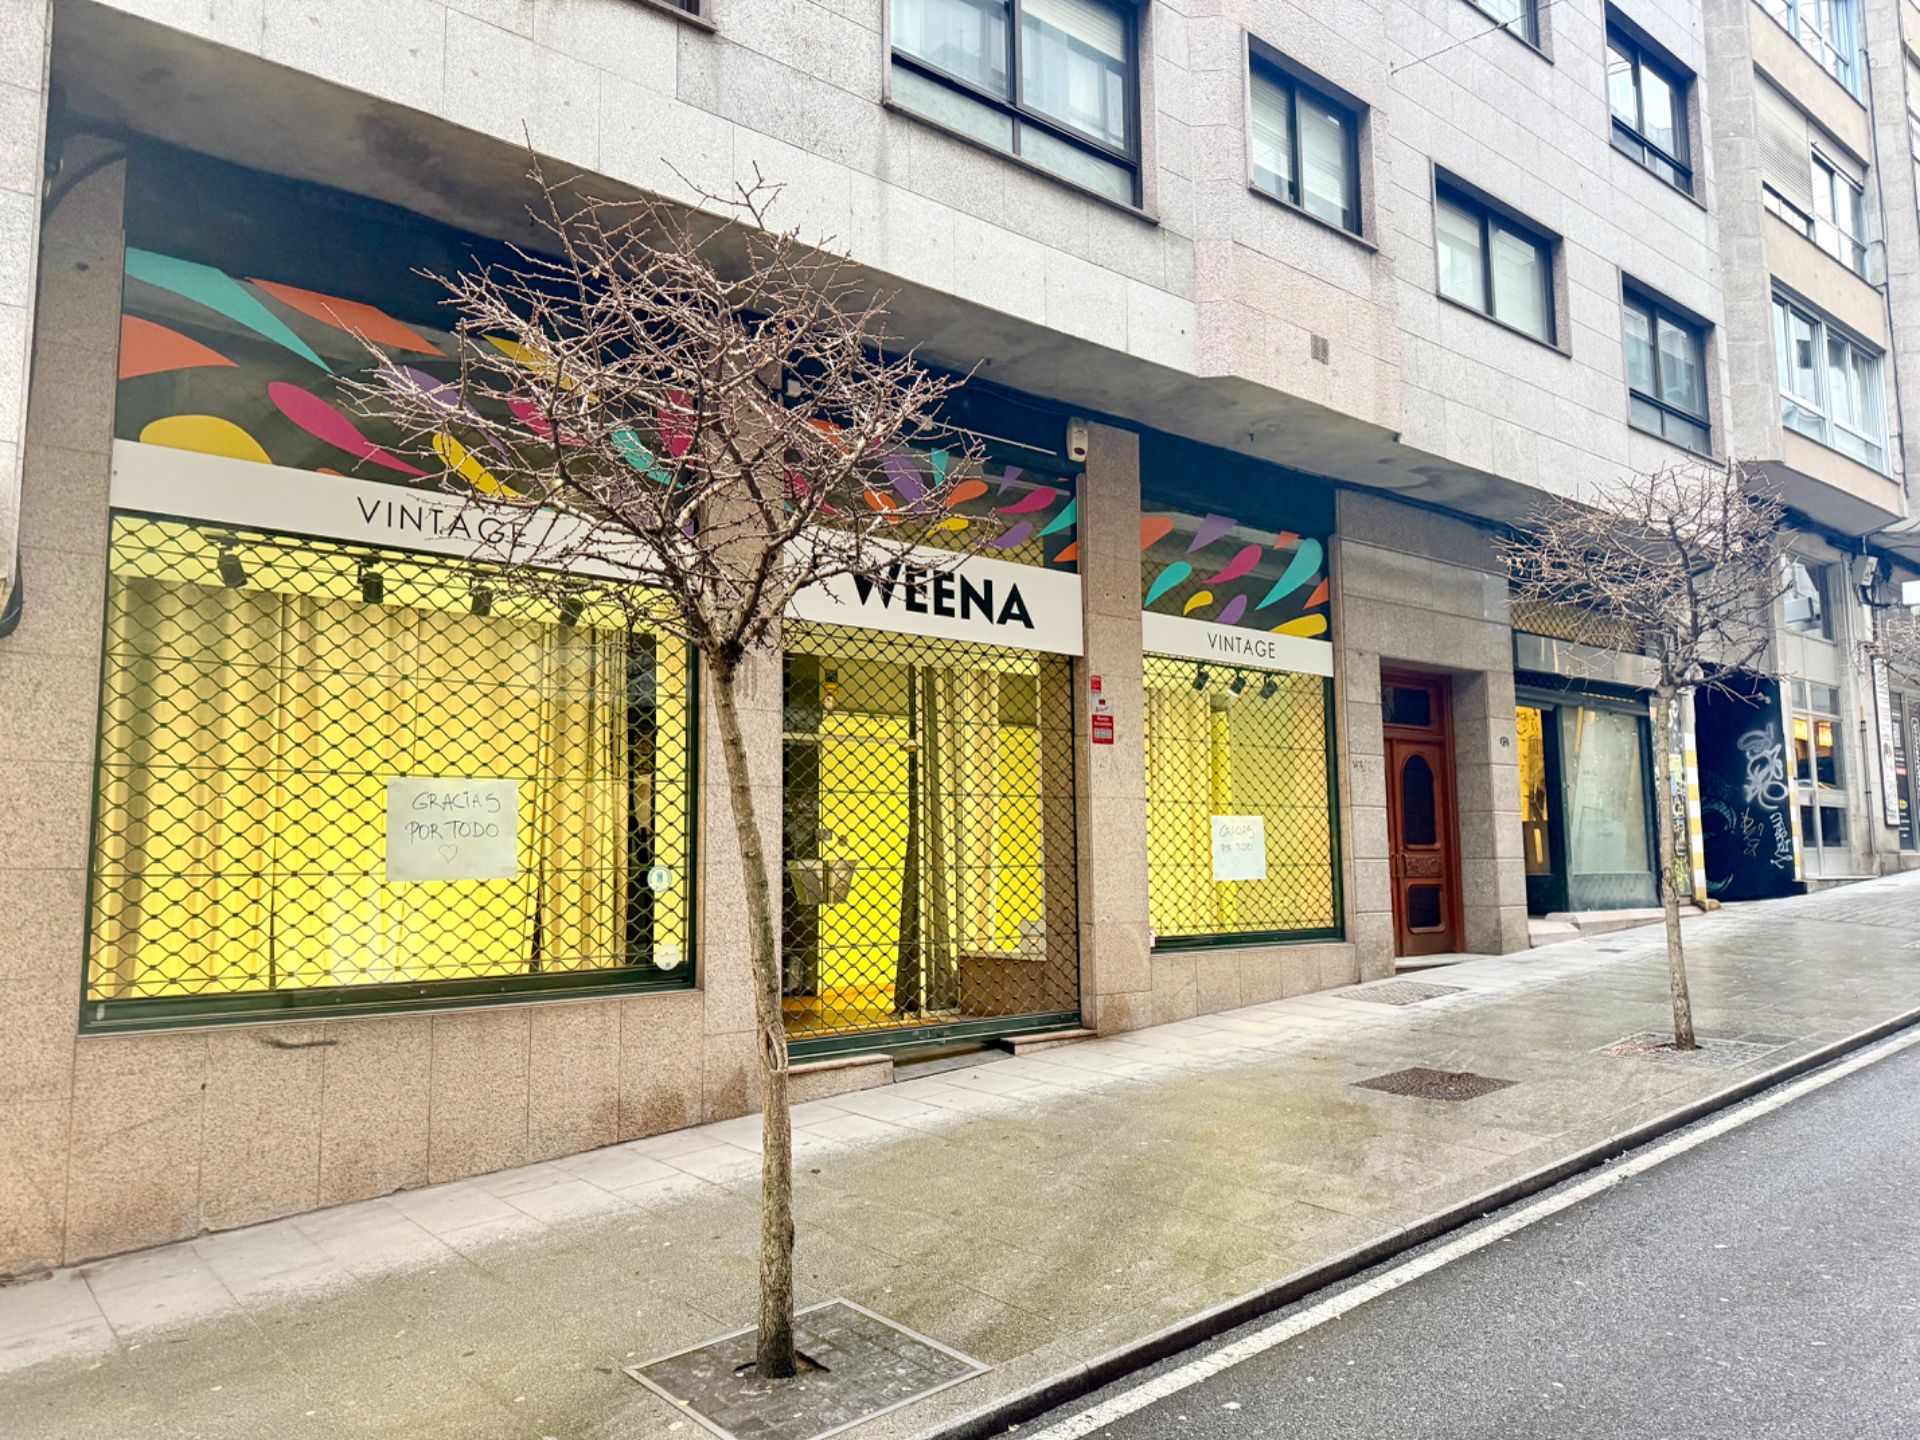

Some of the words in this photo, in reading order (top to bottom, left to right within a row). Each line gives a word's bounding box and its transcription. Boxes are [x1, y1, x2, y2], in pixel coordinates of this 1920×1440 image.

[357, 495, 527, 549] VINTAGE
[845, 554, 1035, 630] WEENA
[1207, 631, 1276, 660] VINTAGE
[411, 789, 501, 814] GRACIAS
[404, 820, 443, 845] POR
[443, 819, 500, 839] TODO
